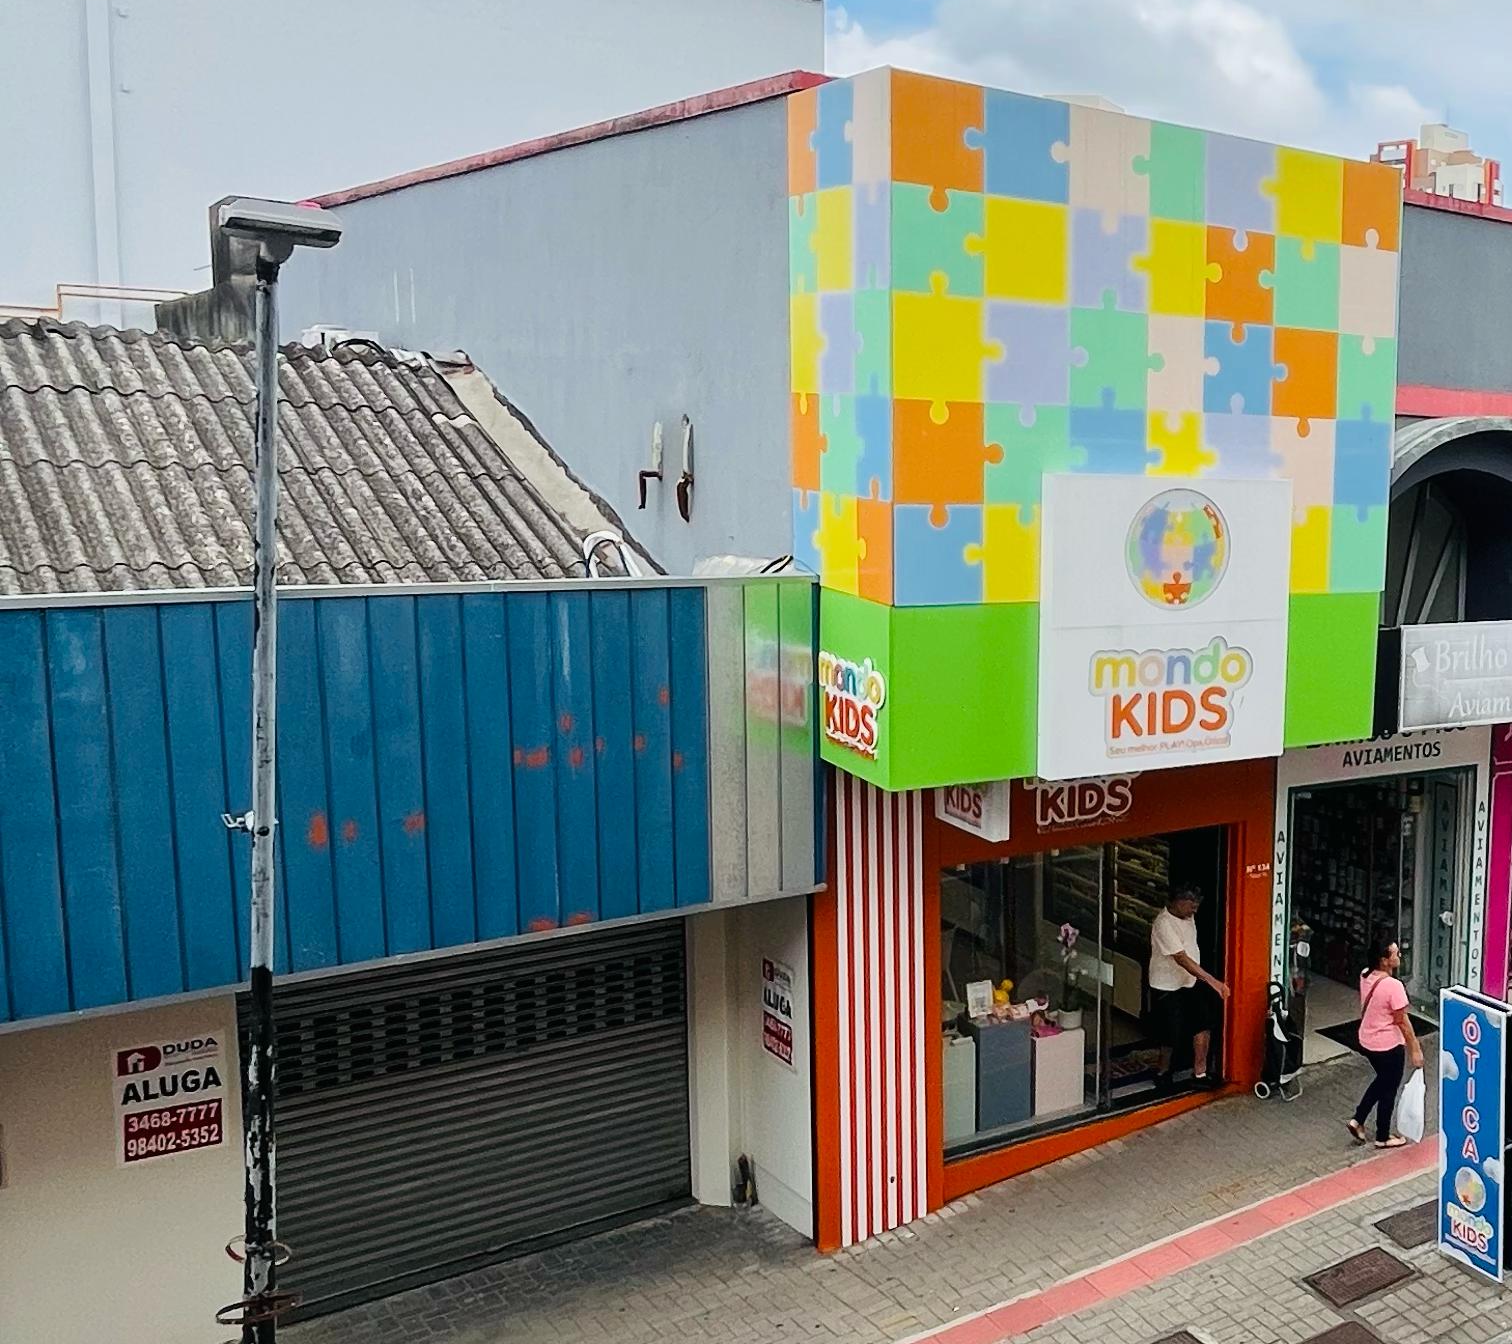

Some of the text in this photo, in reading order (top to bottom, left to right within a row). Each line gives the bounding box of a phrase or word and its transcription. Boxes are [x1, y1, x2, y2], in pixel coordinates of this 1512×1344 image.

[1095, 642, 1247, 689] mondo
[1434, 634, 1507, 674] Brilho
[819, 658, 881, 706] mondo
[825, 691, 875, 747] KIDS
[1111, 686, 1228, 739] KIDS
[1342, 741, 1442, 769] AVIAMENTOS
[944, 785, 983, 819] KIDS
[1039, 778, 1130, 824] KIDS
[1273, 830, 1286, 982] AVIAMENT
[1471, 801, 1486, 979] AVIAMENTOS
[162, 1037, 218, 1055] DUDA
[121, 1066, 222, 1105] ALUGA
[1462, 1013, 1482, 1164] ÓTICA
[128, 1102, 219, 1133] 3468-7777
[127, 1123, 220, 1157] 98402-5352
[1453, 1219, 1487, 1250] KIDS
